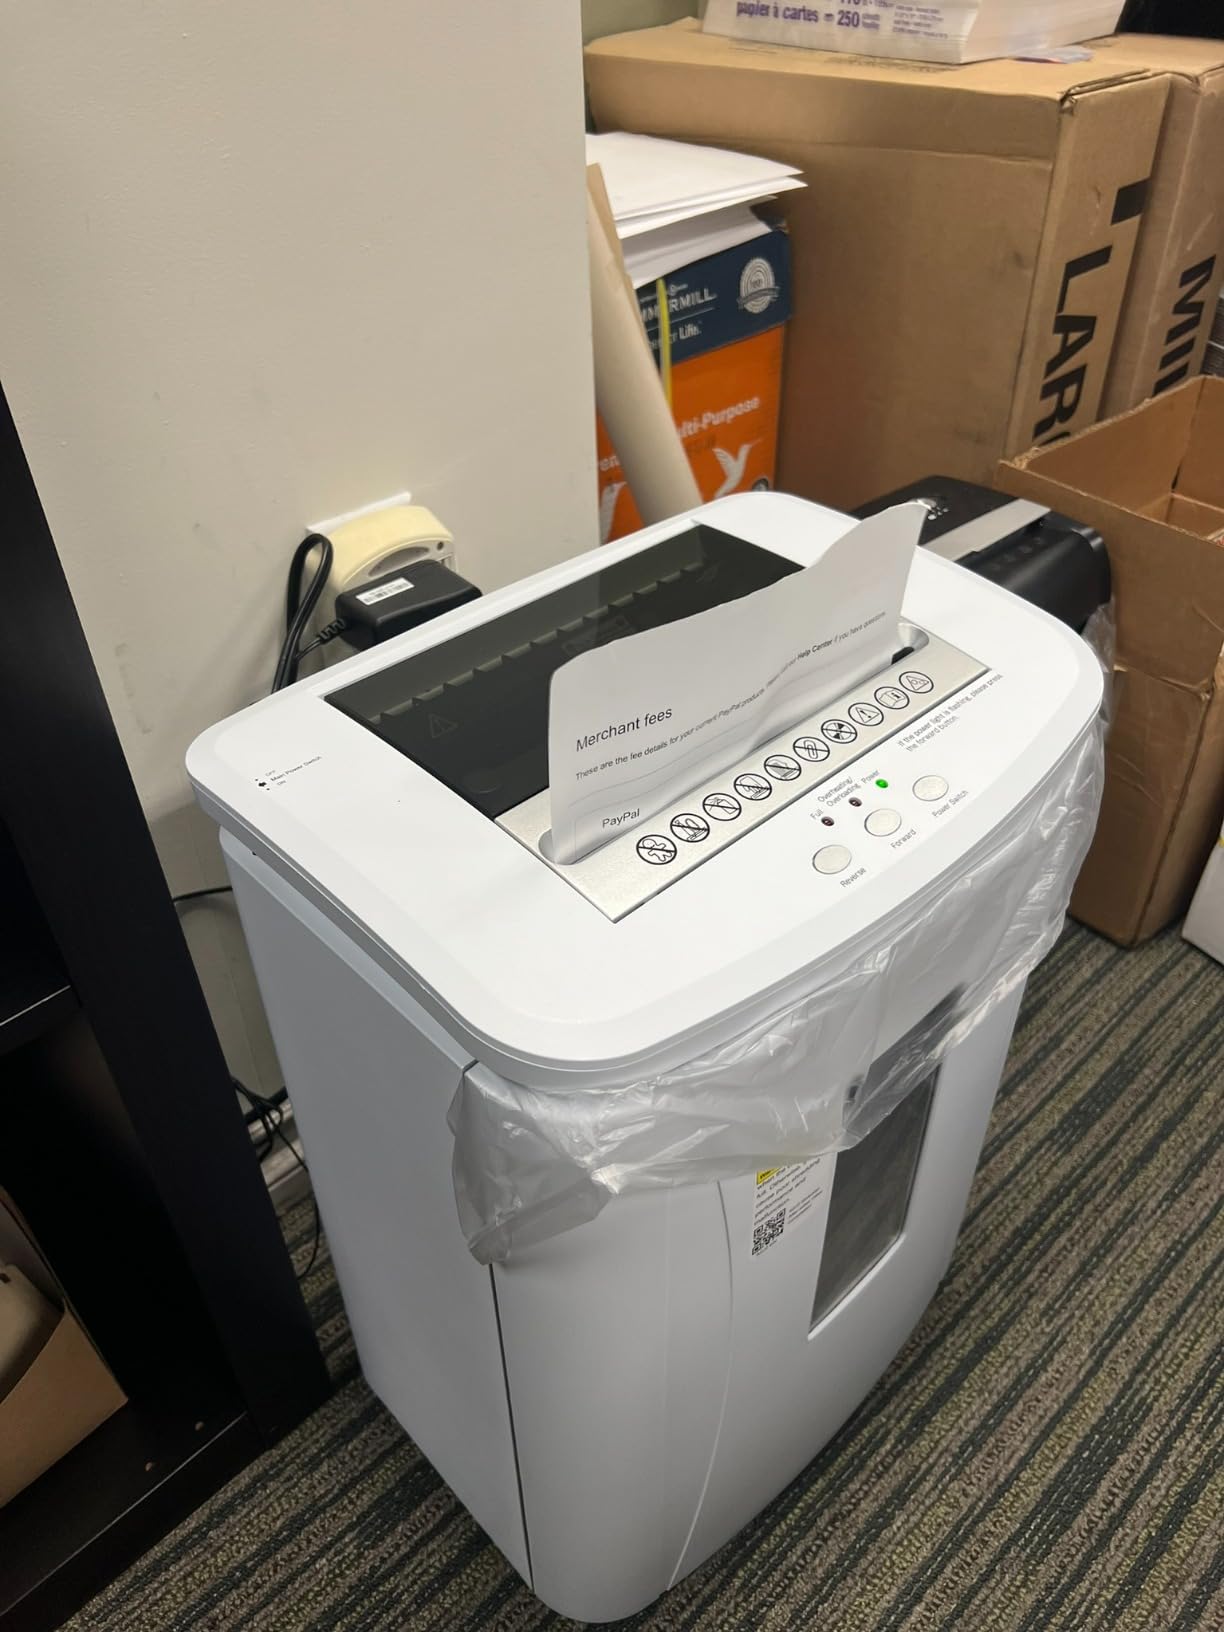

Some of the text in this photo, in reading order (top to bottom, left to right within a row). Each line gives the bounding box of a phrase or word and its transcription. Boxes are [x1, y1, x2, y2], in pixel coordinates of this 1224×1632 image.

[736, 1, 770, 17] papier
[773, 3, 780, 18] à
[783, 5, 818, 22] cartes
[837, 10, 860, 27] 250
[576, 766, 599, 780] These
[600, 760, 614, 770] are
[615, 755, 628, 765] the
[630, 751, 643, 760] fee
[644, 742, 668, 756] details
[670, 735, 680, 744] for
[679, 728, 694, 741] your
[695, 714, 717, 731] current
[718, 703, 741, 719] PayPal
[797, 649, 811, 660] Help
[812, 640, 833, 653] Center
[914, 722, 932, 737] power
[930, 713, 946, 724] light
[971, 684, 989, 697] please
[576, 708, 673, 752] Merchant fees
[916, 727, 941, 744] forward
[861, 770, 880, 784] Power
[817, 776, 853, 802] Overheating/
[810, 808, 824, 819] Full
[932, 790, 969, 818] Power Switch
[602, 808, 640, 829] PayPal
[890, 829, 917, 849] Forward
[840, 867, 867, 888] Reverse
